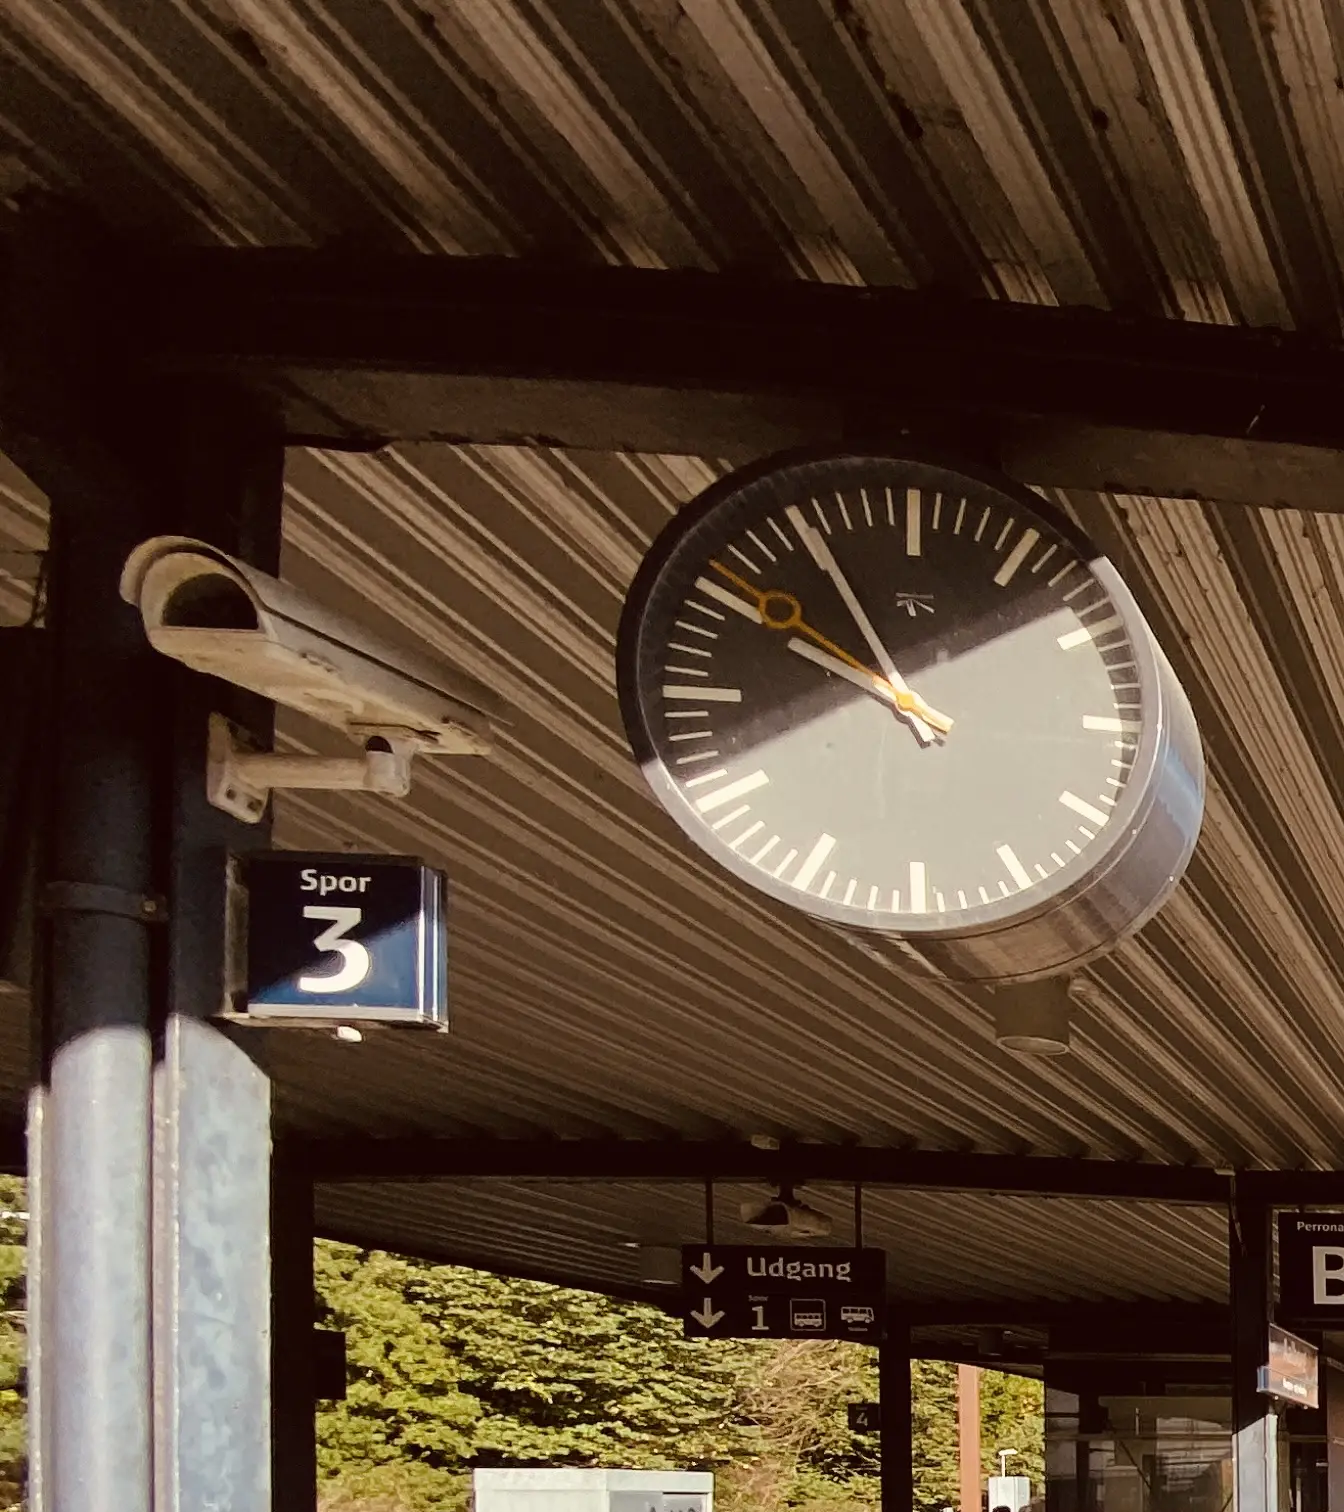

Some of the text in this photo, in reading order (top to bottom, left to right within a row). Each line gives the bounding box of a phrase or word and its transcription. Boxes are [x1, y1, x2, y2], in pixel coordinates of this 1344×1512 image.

[299, 869, 372, 896] Spor
[297, 905, 372, 994] 3
[746, 1256, 852, 1282] Udgang
[751, 1305, 770, 1331] 1
[856, 1412, 868, 1427] 4
